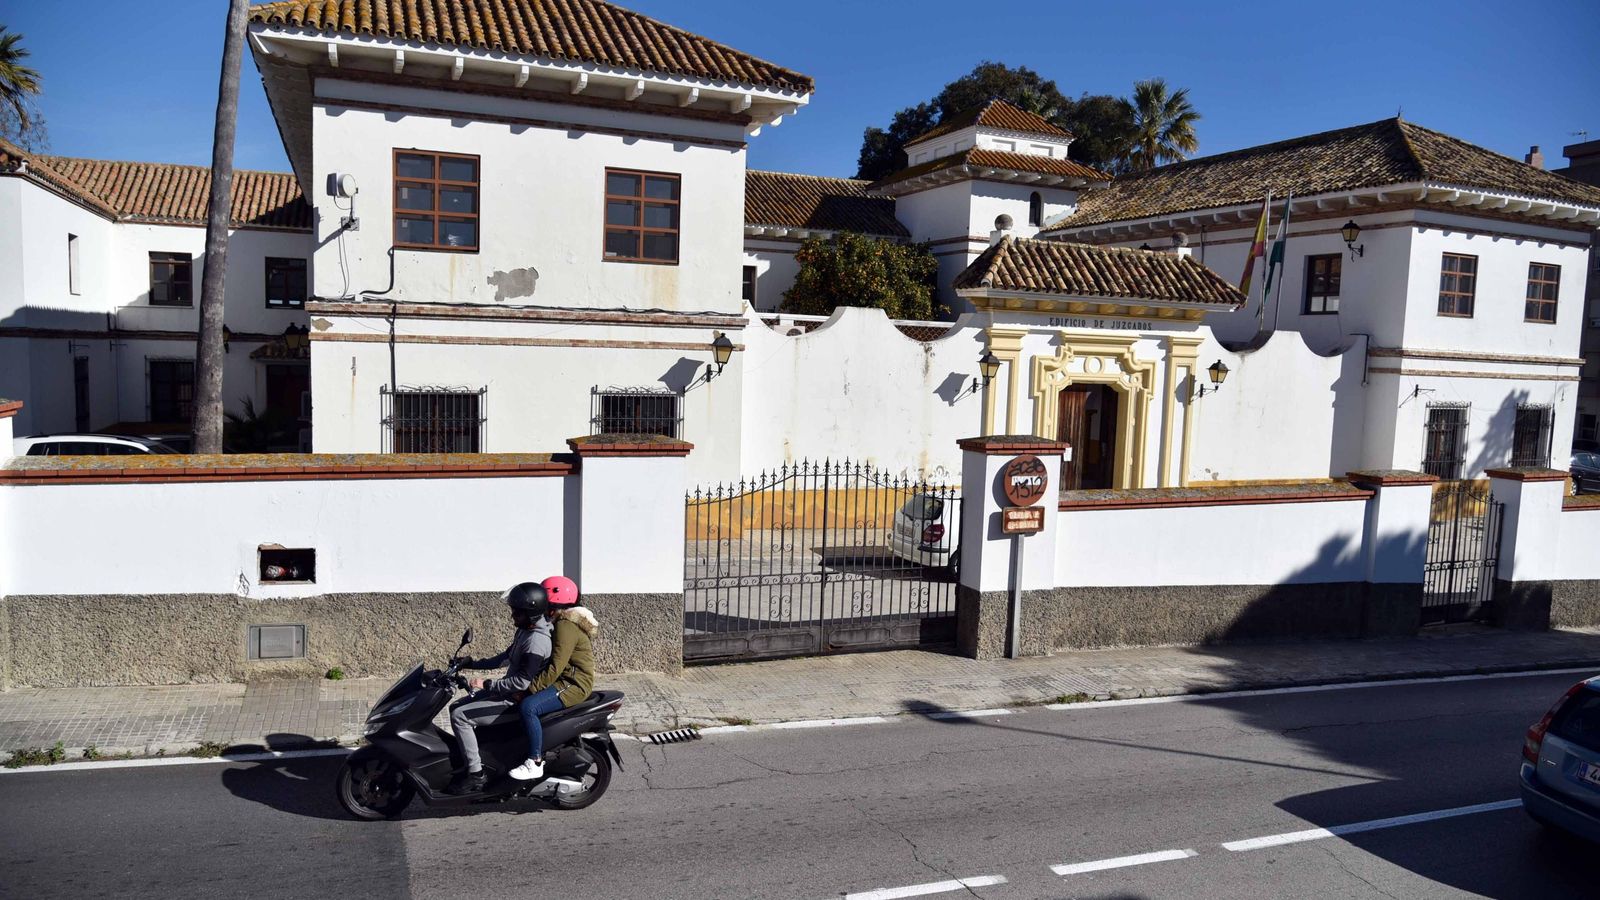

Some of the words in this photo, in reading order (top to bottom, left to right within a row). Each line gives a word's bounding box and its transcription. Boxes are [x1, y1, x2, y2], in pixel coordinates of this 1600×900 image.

[1049, 317, 1086, 327] EDIFICIO
[1094, 319, 1104, 328] DE
[1111, 321, 1152, 330] JUZGADOS
[1010, 476, 1044, 499] 1312
